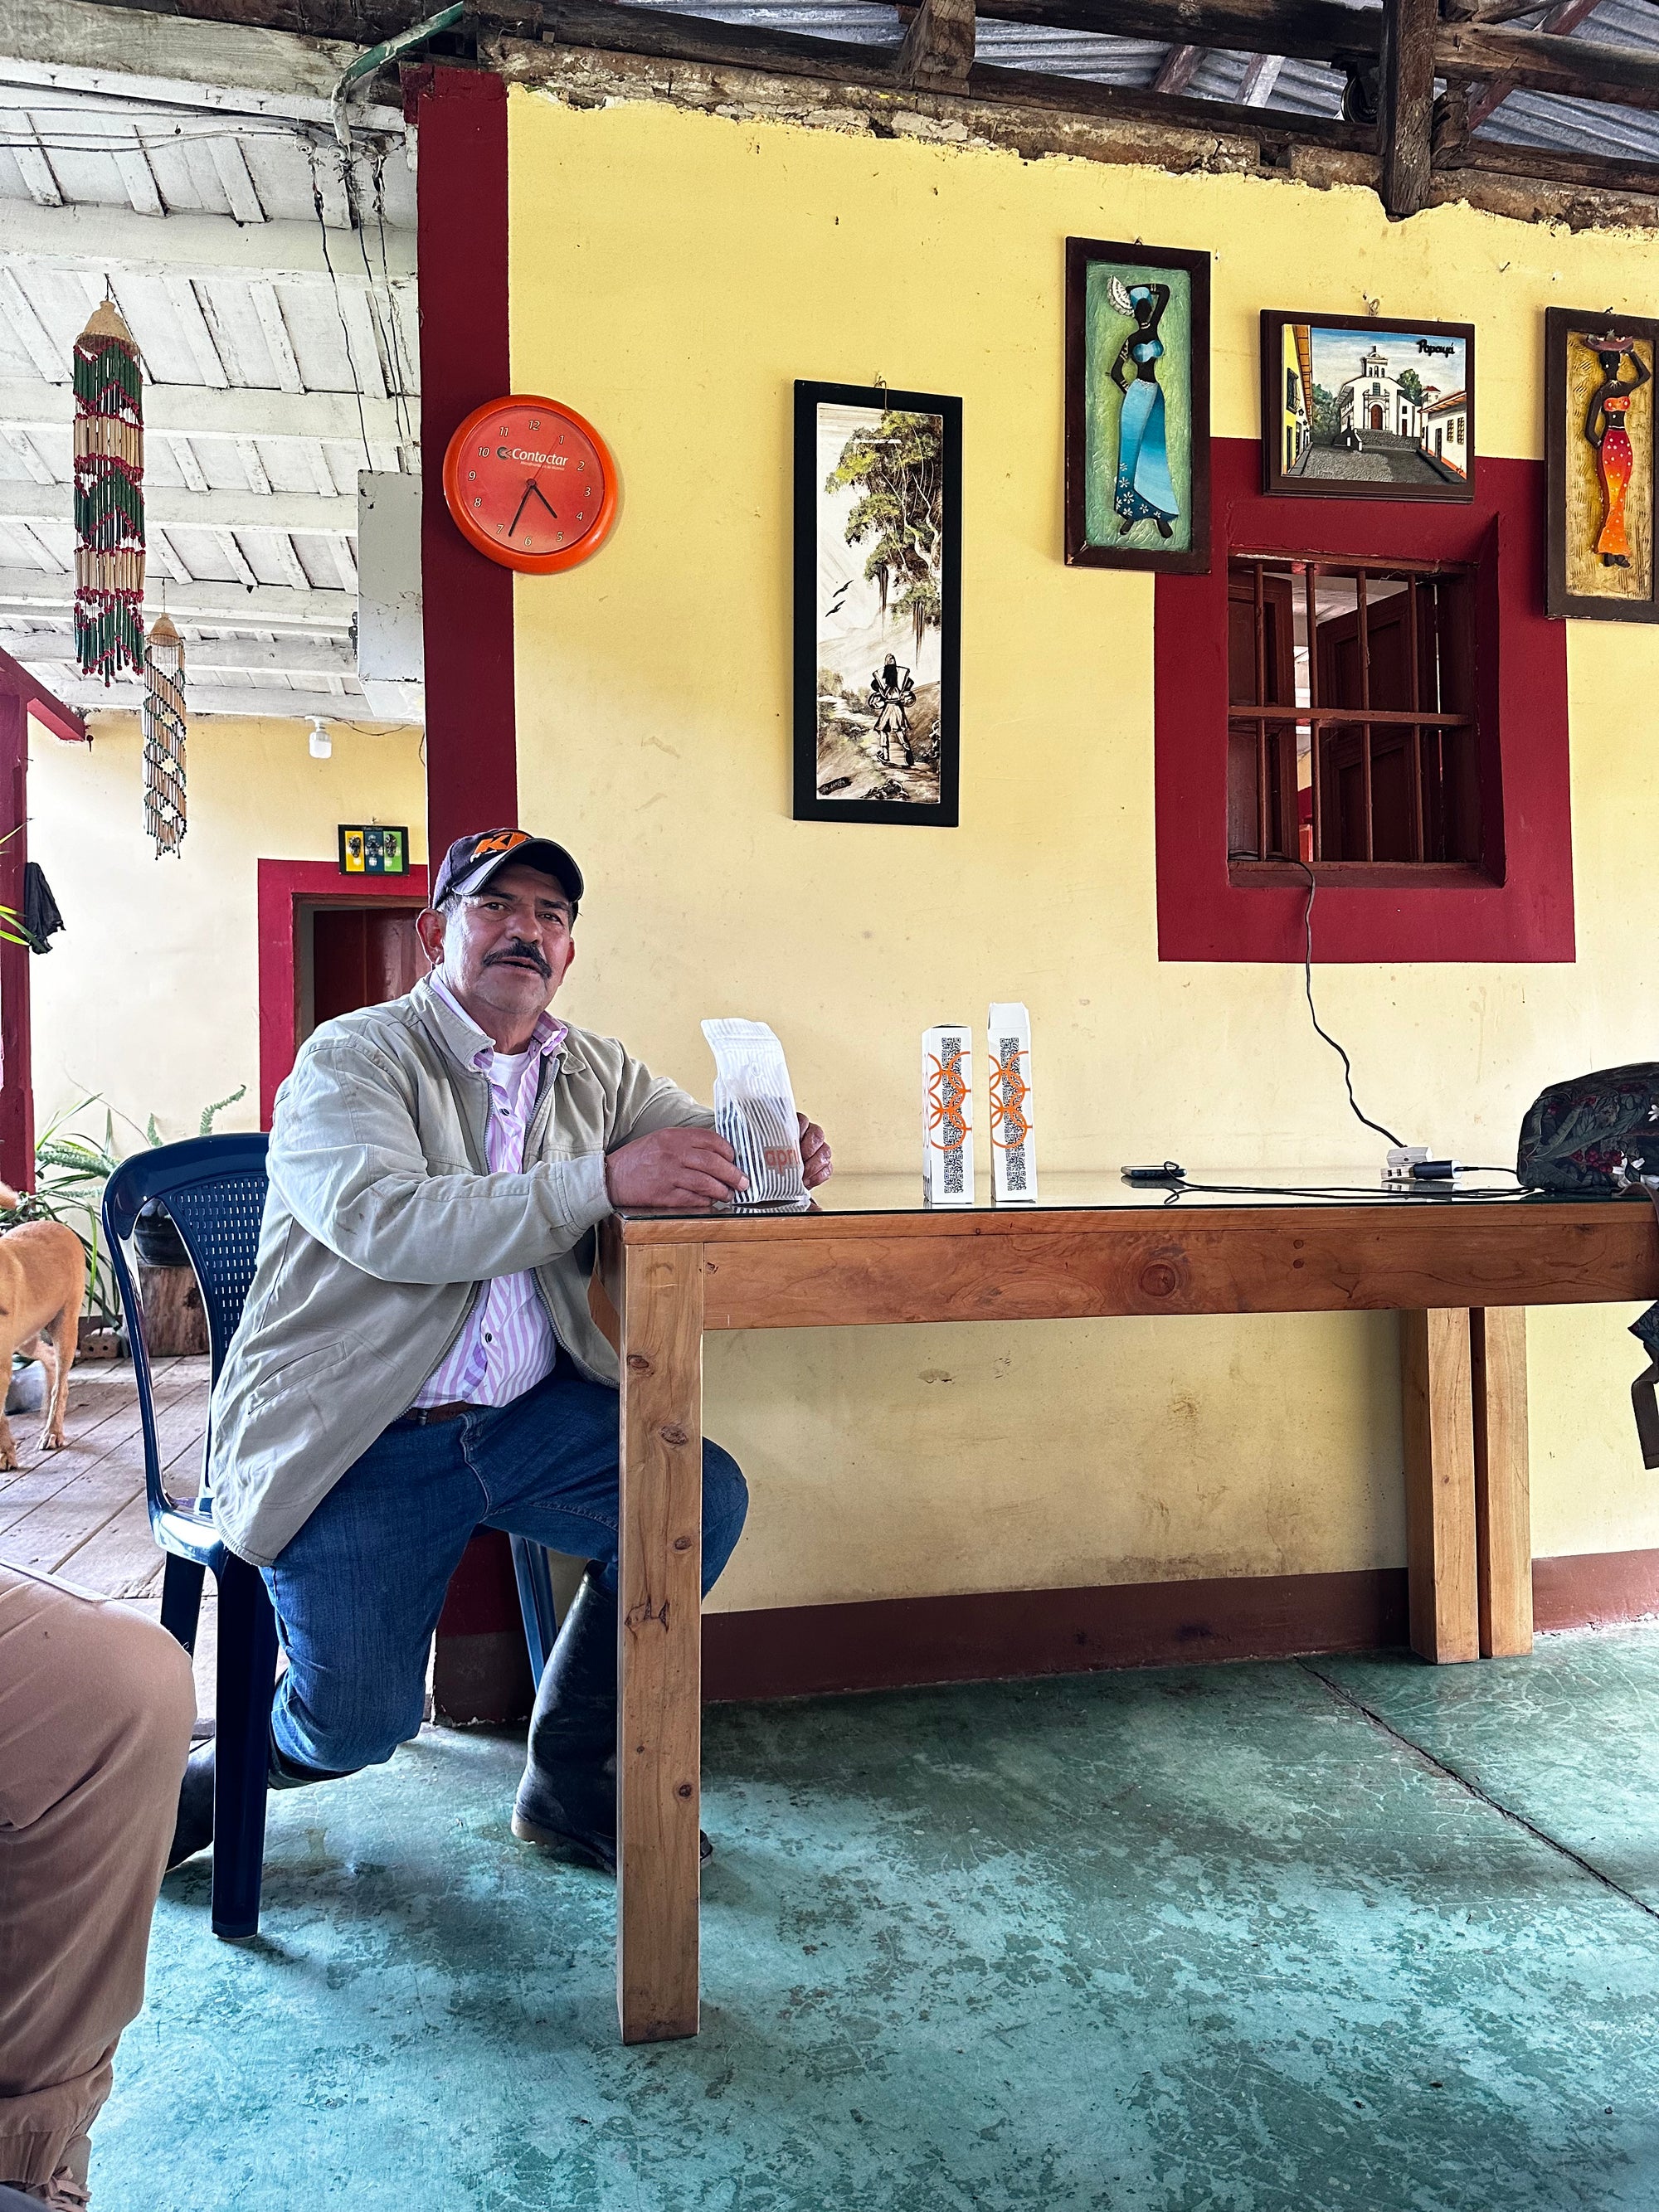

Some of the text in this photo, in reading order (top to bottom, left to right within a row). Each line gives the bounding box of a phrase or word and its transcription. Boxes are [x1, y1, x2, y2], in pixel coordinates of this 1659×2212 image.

[528, 421, 540, 430] 12
[499, 426, 508, 436] 11
[558, 435, 564, 444] 1
[478, 447, 489, 457] 10
[512, 448, 568, 465] Contactar
[577, 461, 585, 471] 2
[468, 471, 476, 480] 9
[584, 487, 591, 497] 3
[474, 498, 482, 508] 8
[576, 512, 583, 521] 4
[496, 524, 504, 534] 7
[524, 536, 532, 546] 6
[556, 532, 563, 542] 5
